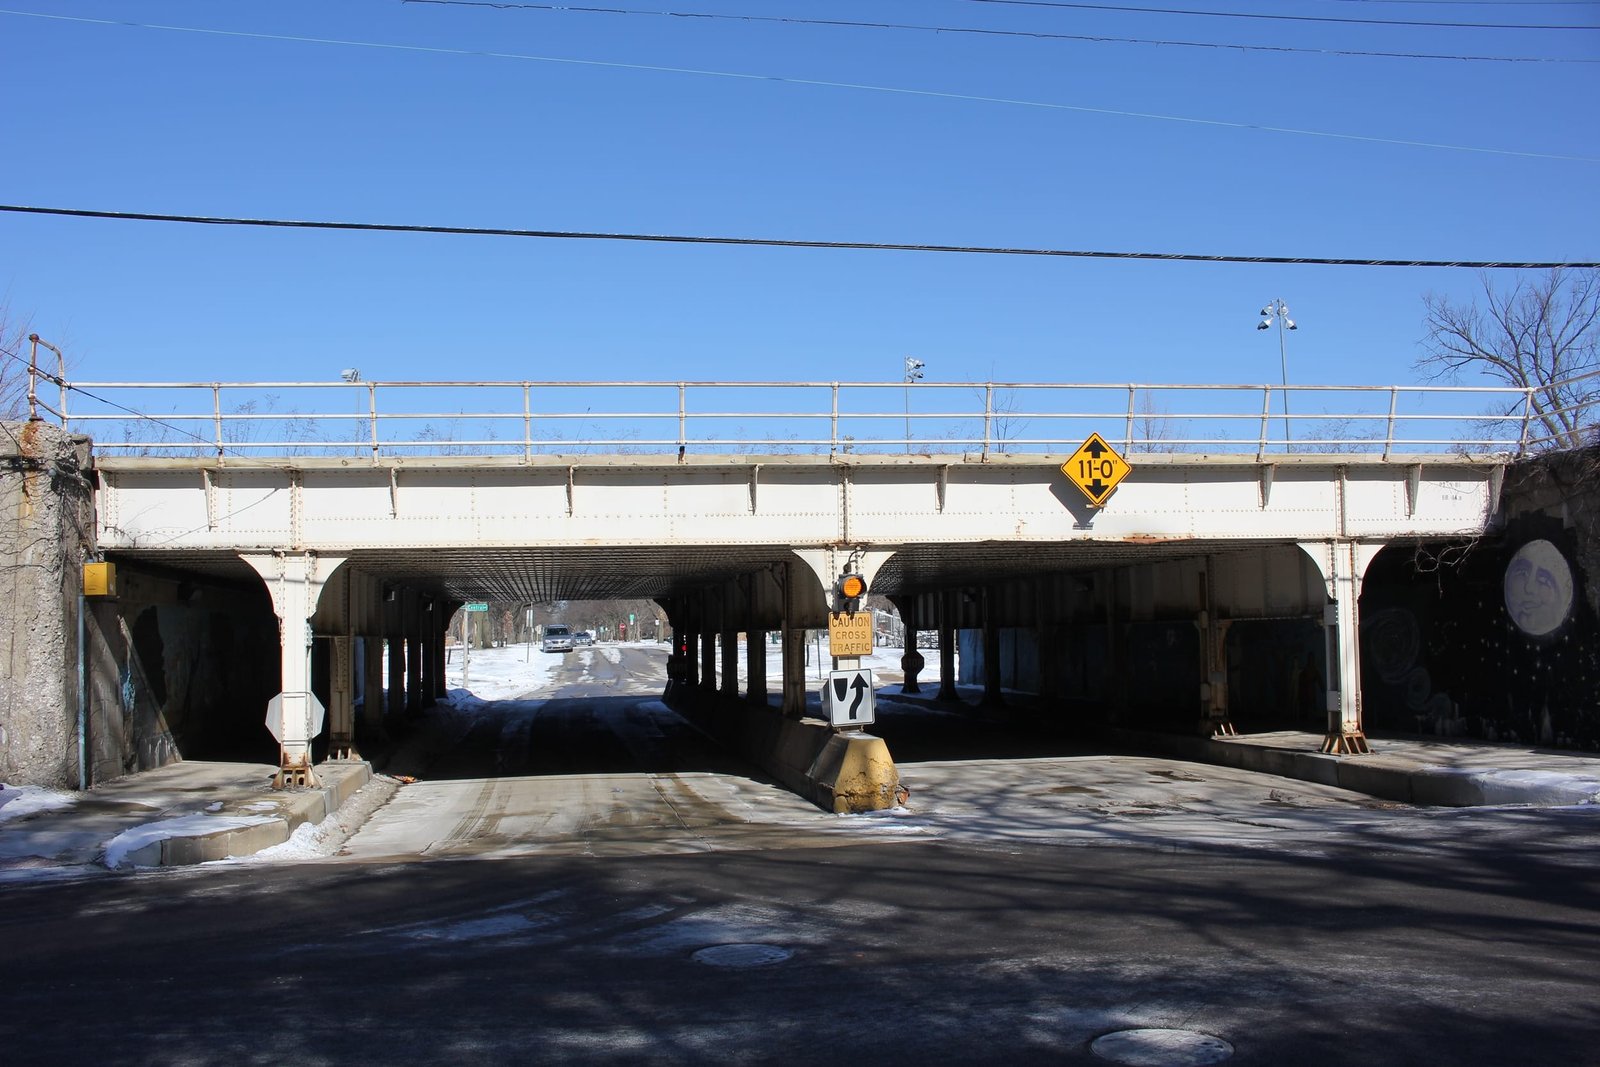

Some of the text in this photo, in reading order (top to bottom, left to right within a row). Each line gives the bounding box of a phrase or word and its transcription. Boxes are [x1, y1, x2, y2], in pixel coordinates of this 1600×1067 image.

[832, 617, 870, 627] CAUTION
[835, 631, 867, 640] CROSS
[832, 643, 870, 652] TRAFFIC
